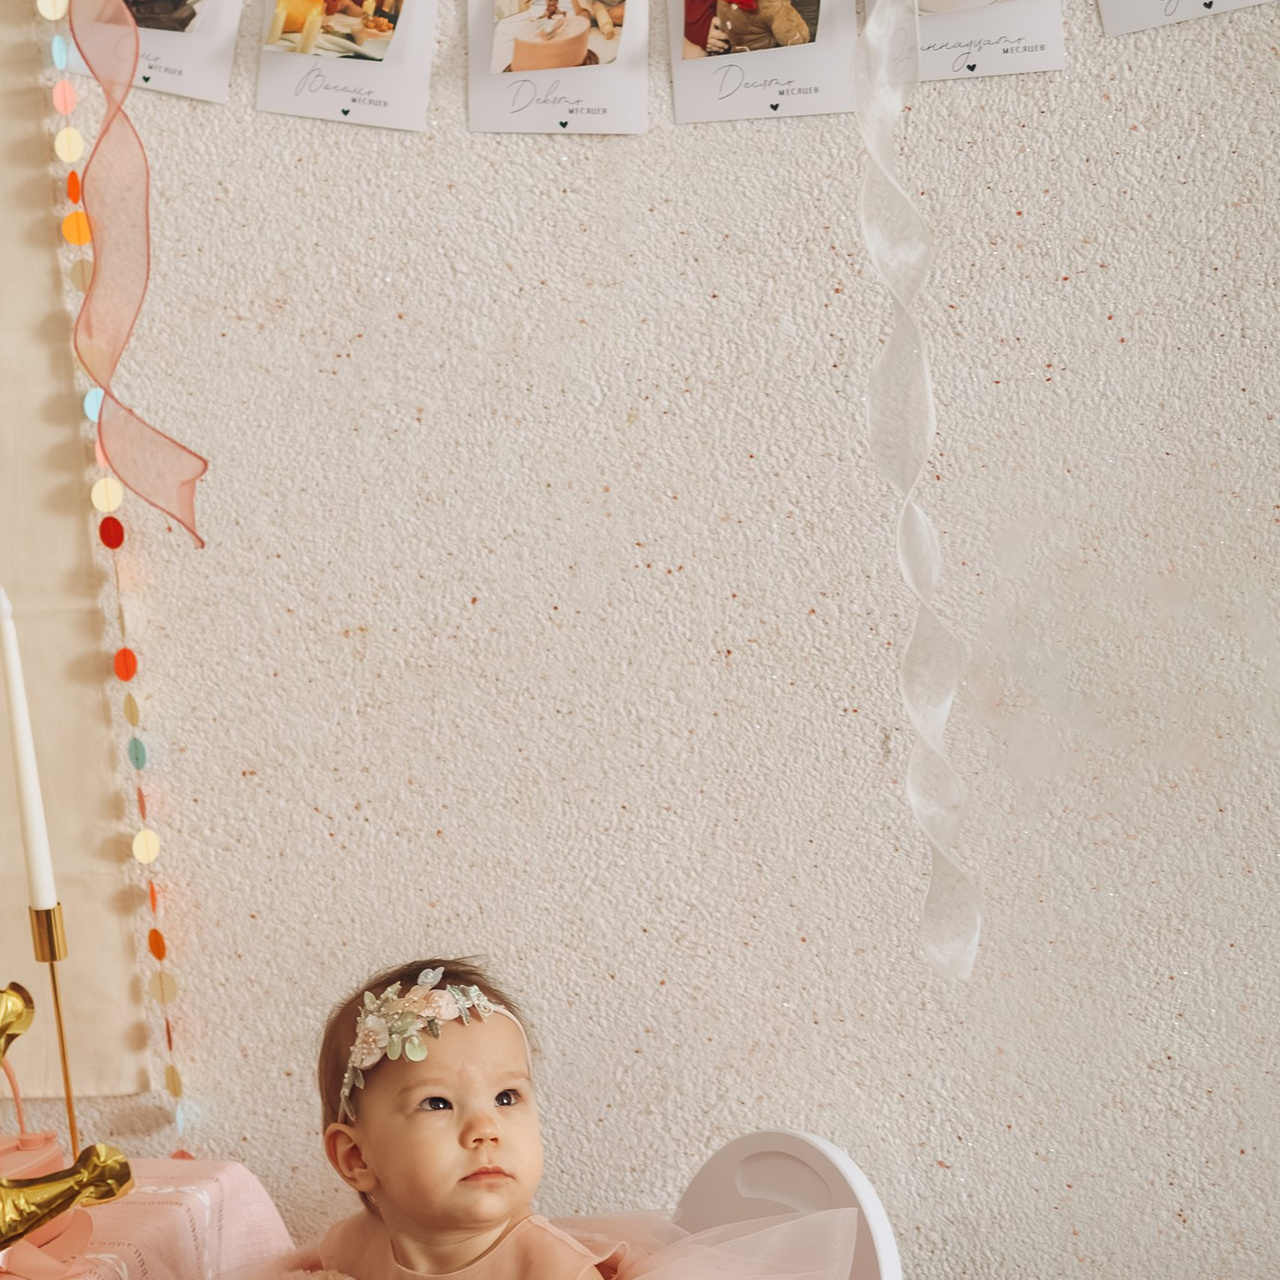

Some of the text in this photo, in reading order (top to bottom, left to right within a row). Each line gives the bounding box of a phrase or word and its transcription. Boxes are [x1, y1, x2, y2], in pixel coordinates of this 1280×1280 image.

[1002, 43, 1046, 55] МЕСЯЦЕВ
[713, 64, 795, 100] Десять
[778, 86, 820, 96] МЕСЯЦЕВ
[507, 79, 584, 114] Девять
